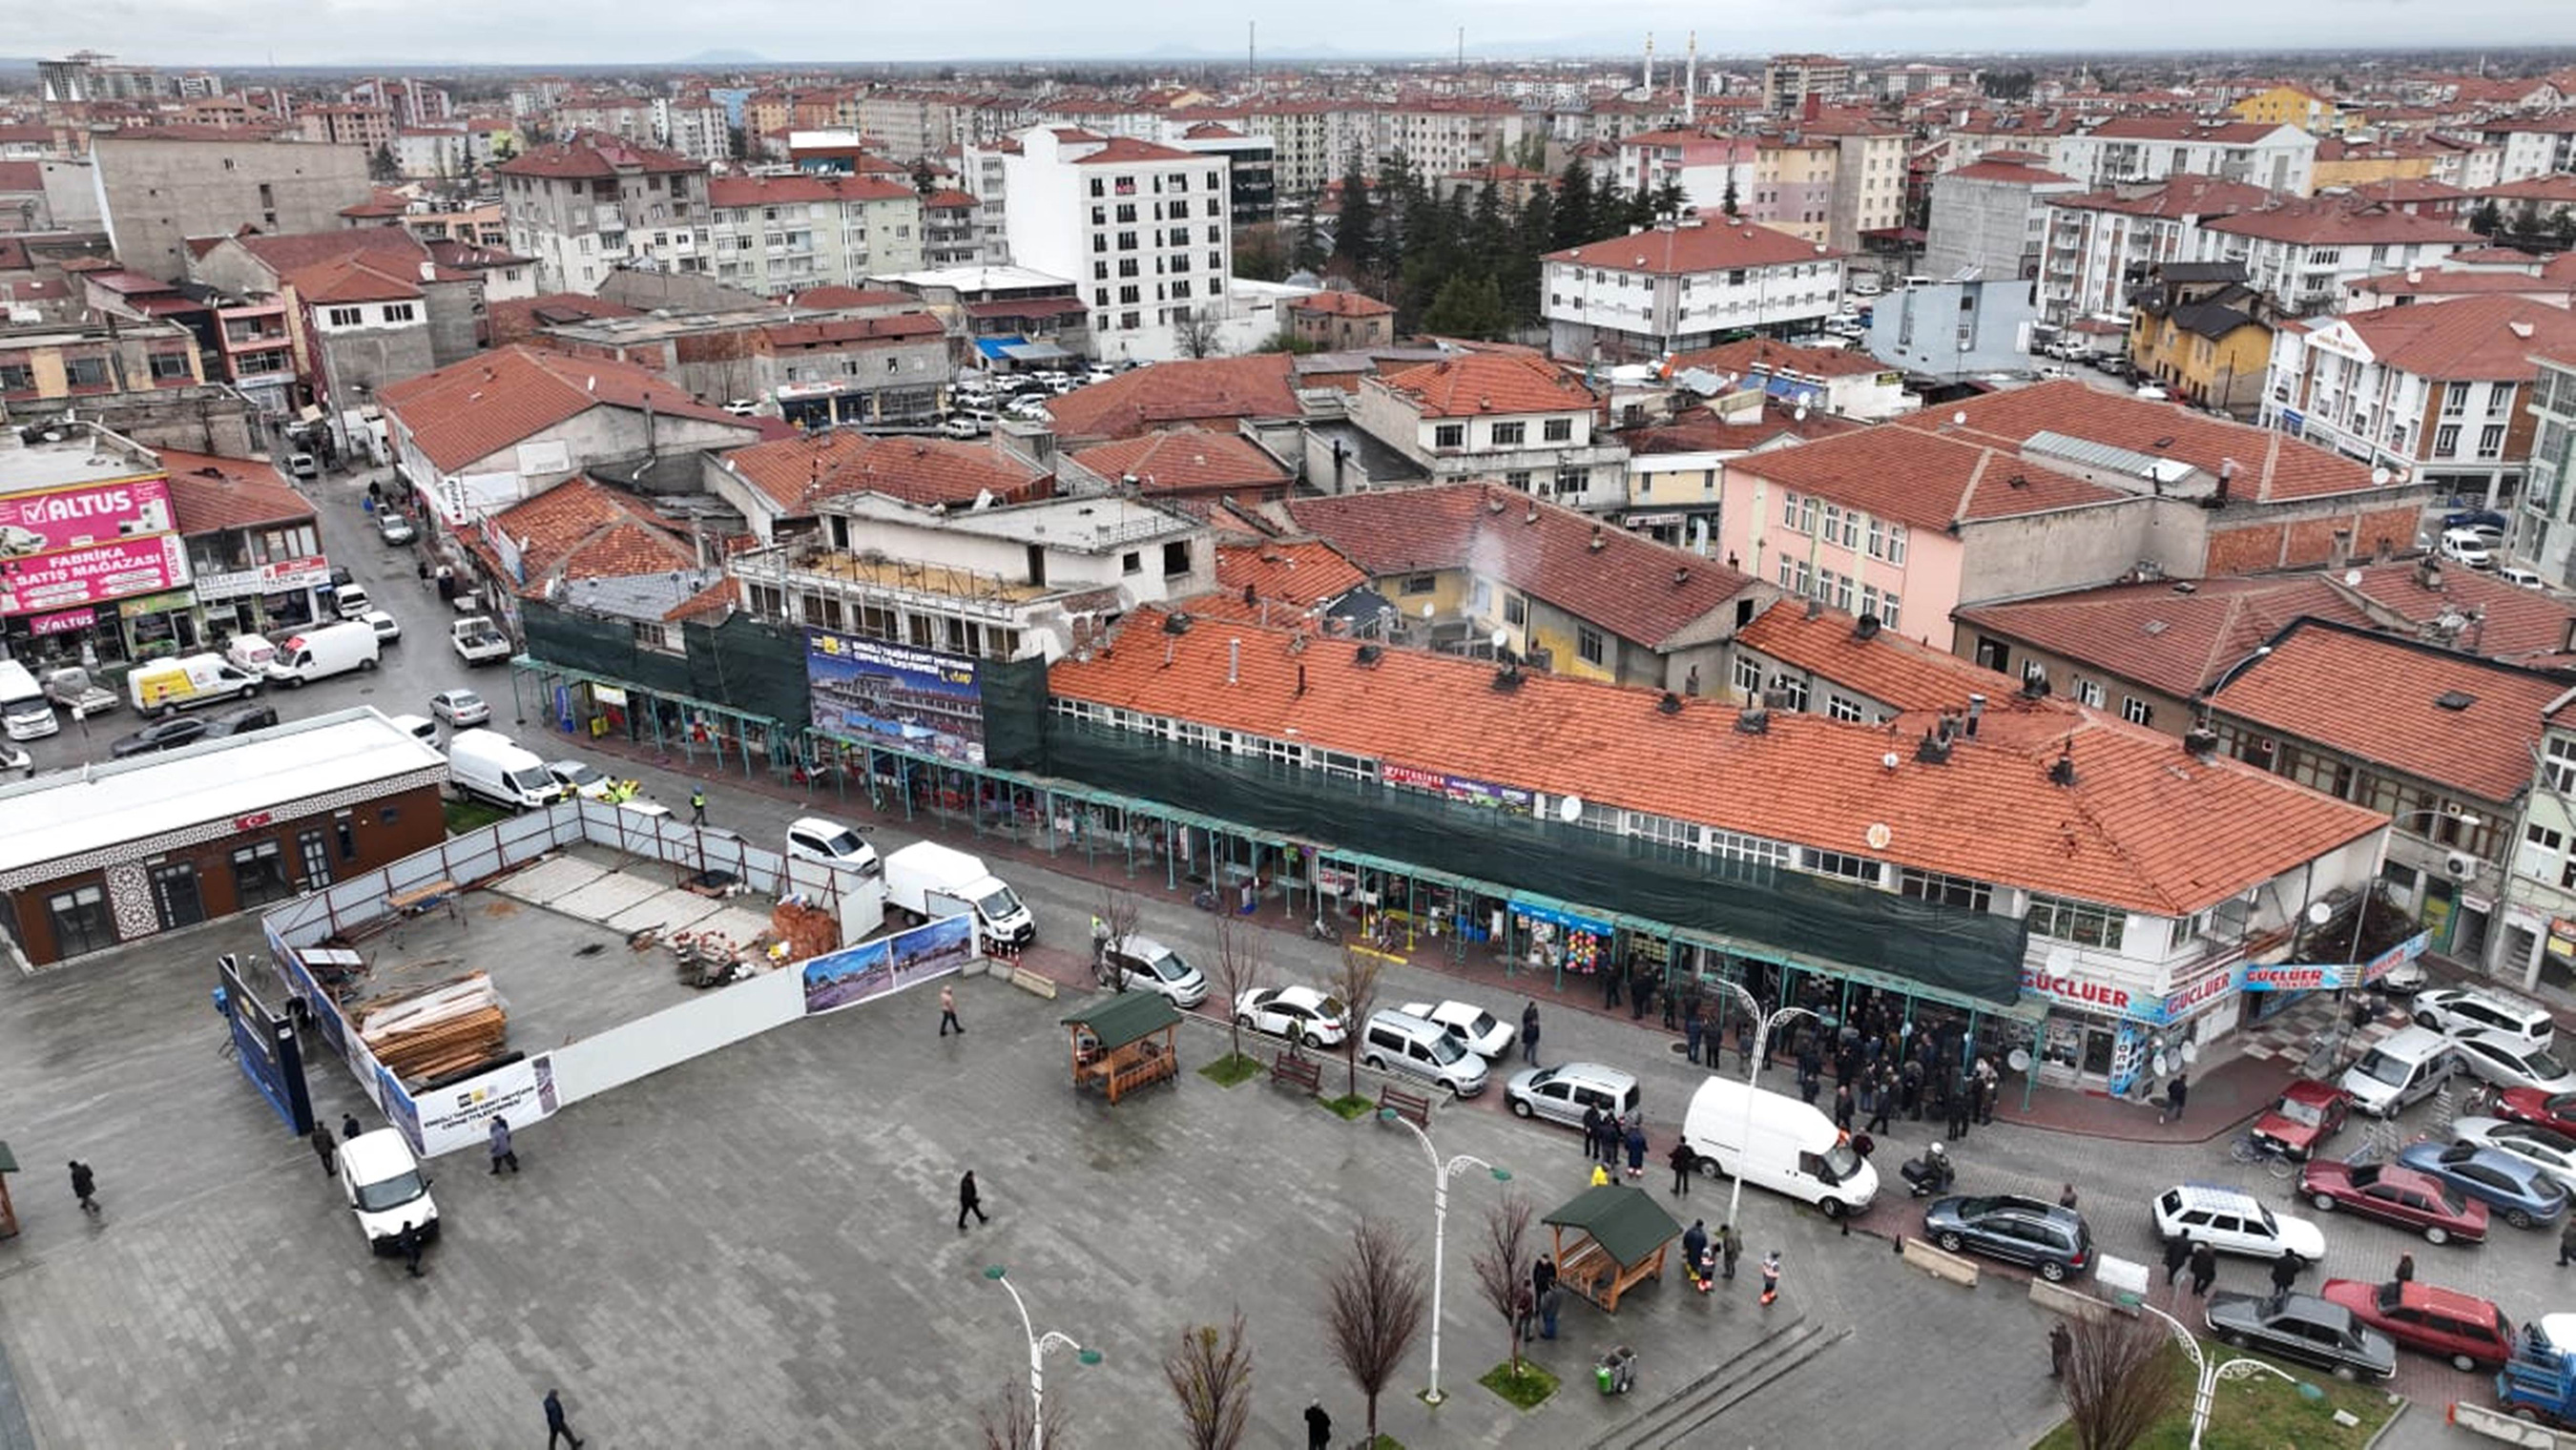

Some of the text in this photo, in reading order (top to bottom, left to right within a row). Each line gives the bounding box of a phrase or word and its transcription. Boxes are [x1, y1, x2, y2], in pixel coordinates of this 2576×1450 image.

[48, 490, 133, 522] ALTUS
[15, 553, 162, 587] SATIŞ MAĞAZASI
[49, 547, 126, 570] FABRİKA
[51, 615, 94, 632] ALTUS
